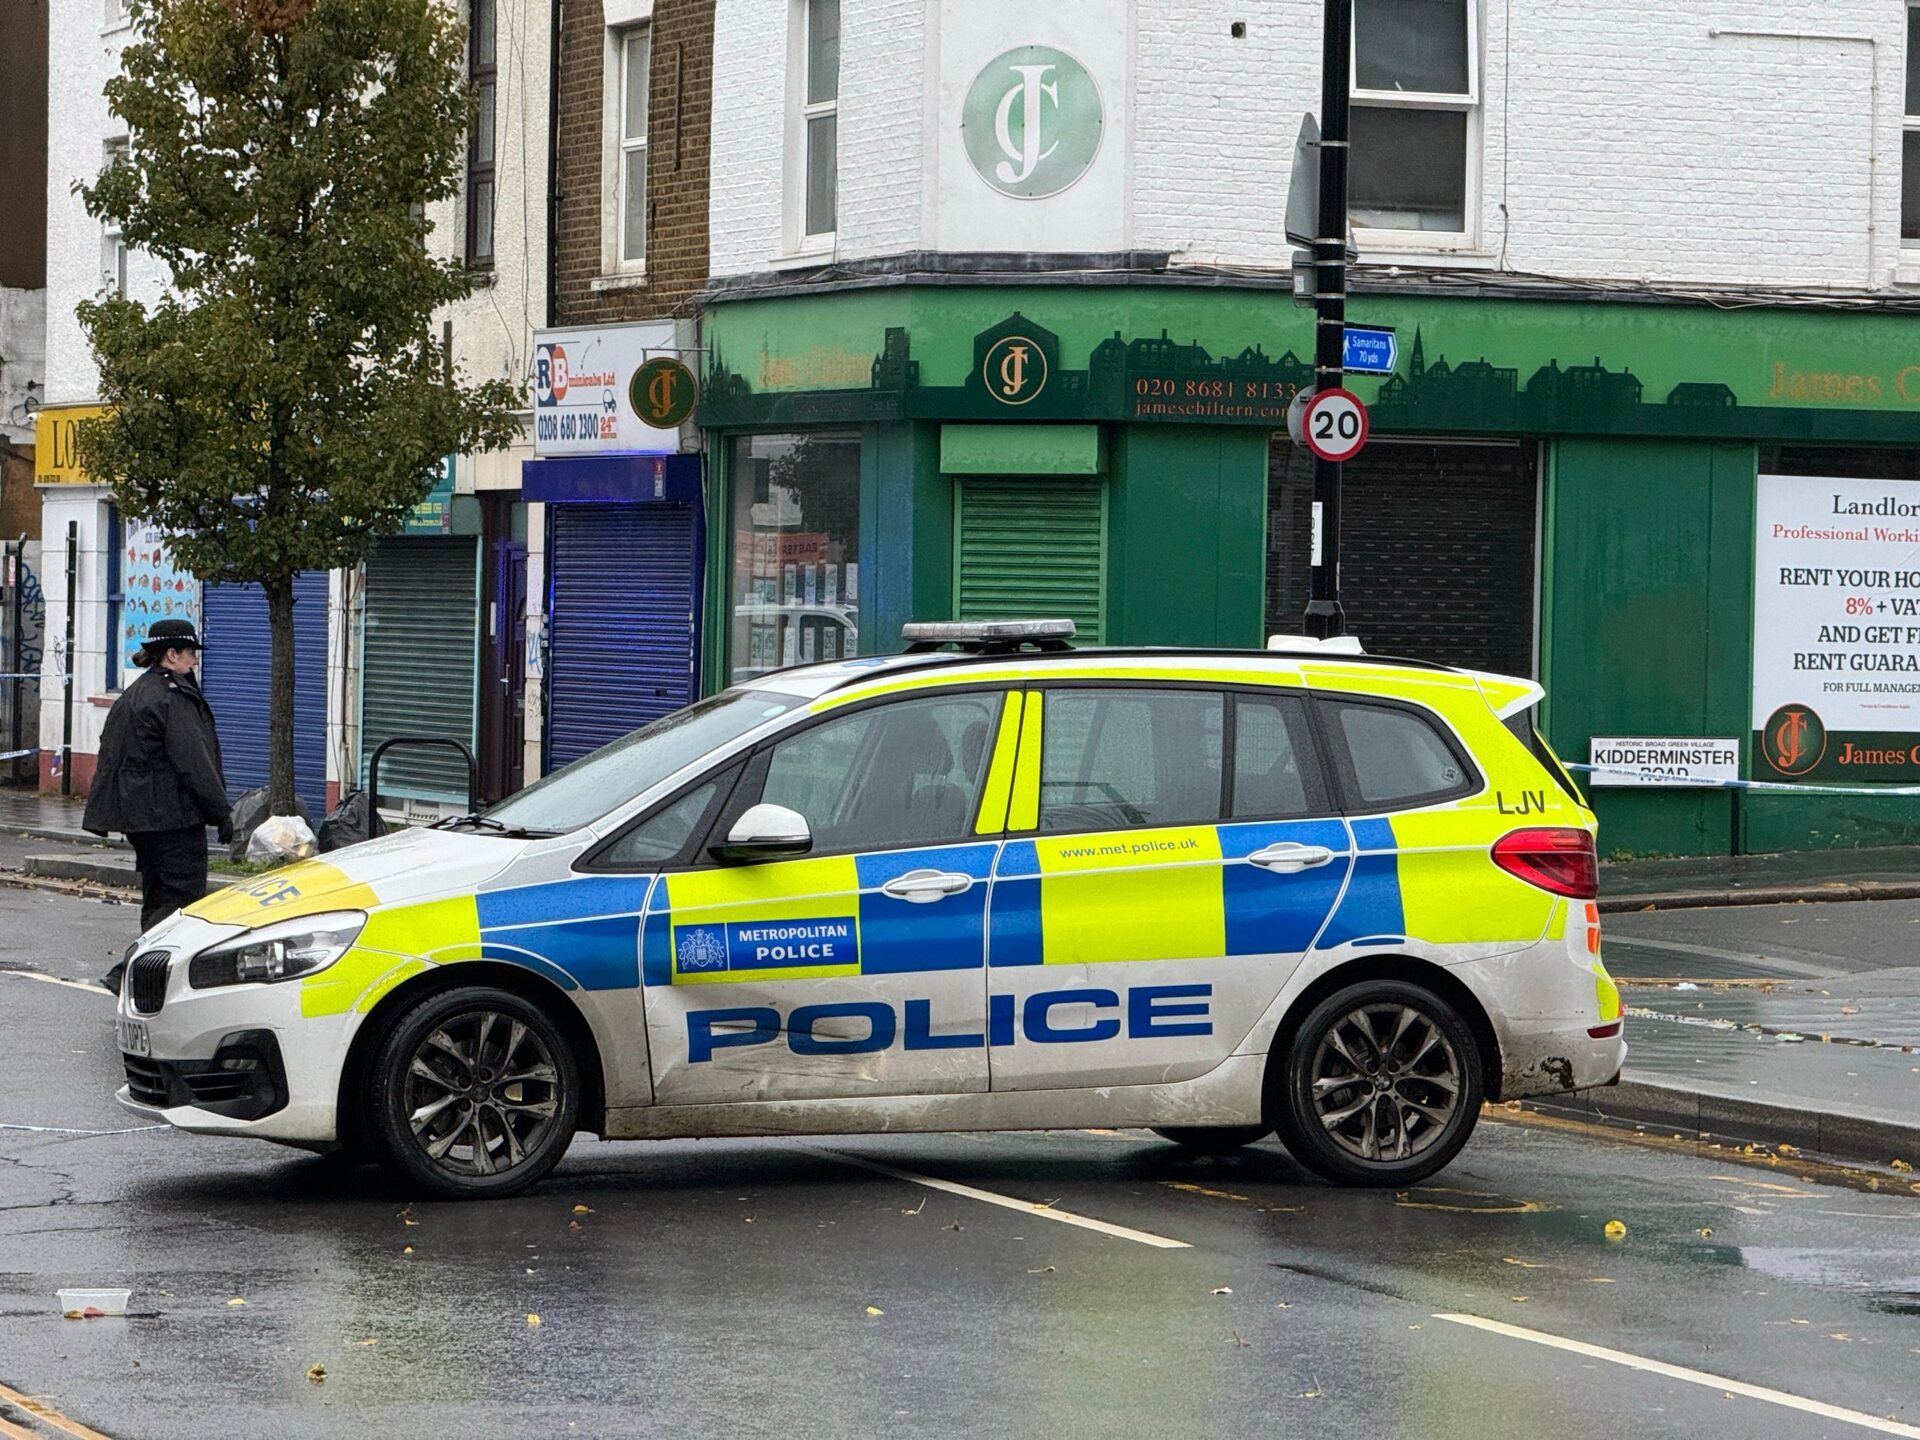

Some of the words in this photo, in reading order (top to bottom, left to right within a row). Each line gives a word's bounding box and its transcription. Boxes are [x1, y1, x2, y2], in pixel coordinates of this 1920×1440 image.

[1352, 335, 1387, 350] Samaritans
[1359, 350, 1367, 362] 70
[1368, 352, 1378, 365] yds
[569, 372, 602, 388] minicabs
[603, 371, 615, 386] Ltd
[1769, 361, 1882, 400] James
[1136, 379, 1176, 396] 020
[1185, 380, 1233, 398] 8681
[1246, 382, 1296, 400] 8133
[538, 413, 558, 441] 0208
[560, 413, 577, 441] 680
[579, 412, 599, 440] 2300
[600, 416, 611, 432] 24
[1314, 411, 1359, 439] 20
[1832, 495, 1920, 517] Landlor
[1773, 524, 1868, 541] Professional
[1779, 567, 1832, 586] RENT
[1836, 569, 1890, 588] YOUR
[1894, 571, 1920, 588] HO
[1846, 597, 1873, 616] 8%
[1876, 601, 1887, 613] +
[1817, 625, 1861, 643] AND
[1865, 626, 1903, 644] GET
[1793, 653, 1846, 671] RENT
[1823, 682, 1844, 693] FOR
[1845, 683, 1871, 693] FULL
[1873, 683, 1920, 693] MANAGE
[1595, 749, 1734, 765] KIDDERMINSTER
[1838, 743, 1905, 765] James
[1496, 790, 1545, 815] LJV
[1060, 838, 1199, 858] www.met.police.uk
[739, 924, 848, 942] METROPOLITAN
[756, 943, 834, 960] POLICE
[686, 983, 1213, 1064] POLICE
